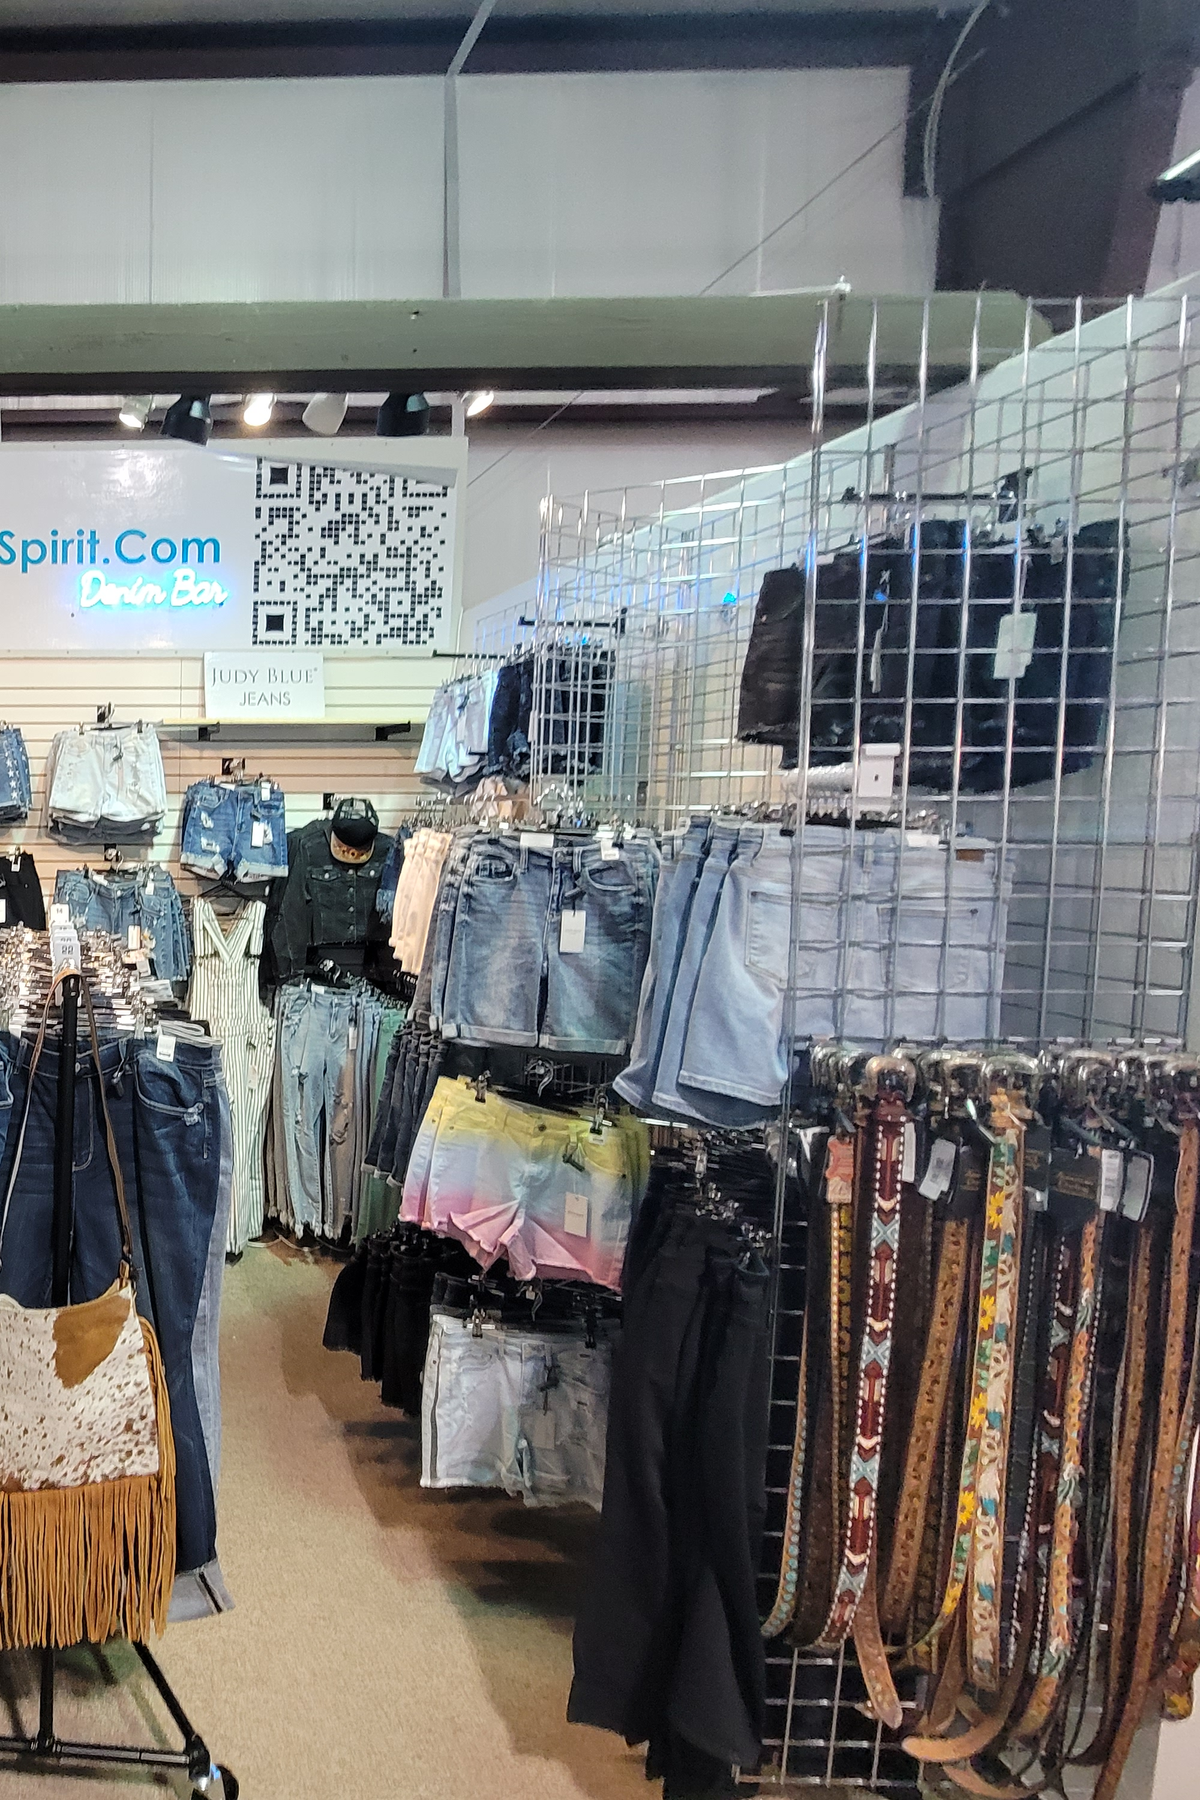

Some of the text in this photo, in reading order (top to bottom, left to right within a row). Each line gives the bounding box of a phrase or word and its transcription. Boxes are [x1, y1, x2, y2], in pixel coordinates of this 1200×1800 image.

[80, 567, 229, 608] Denim Bar
[212, 667, 315, 688] JUDY BLUE
[239, 691, 292, 707] JEANS
